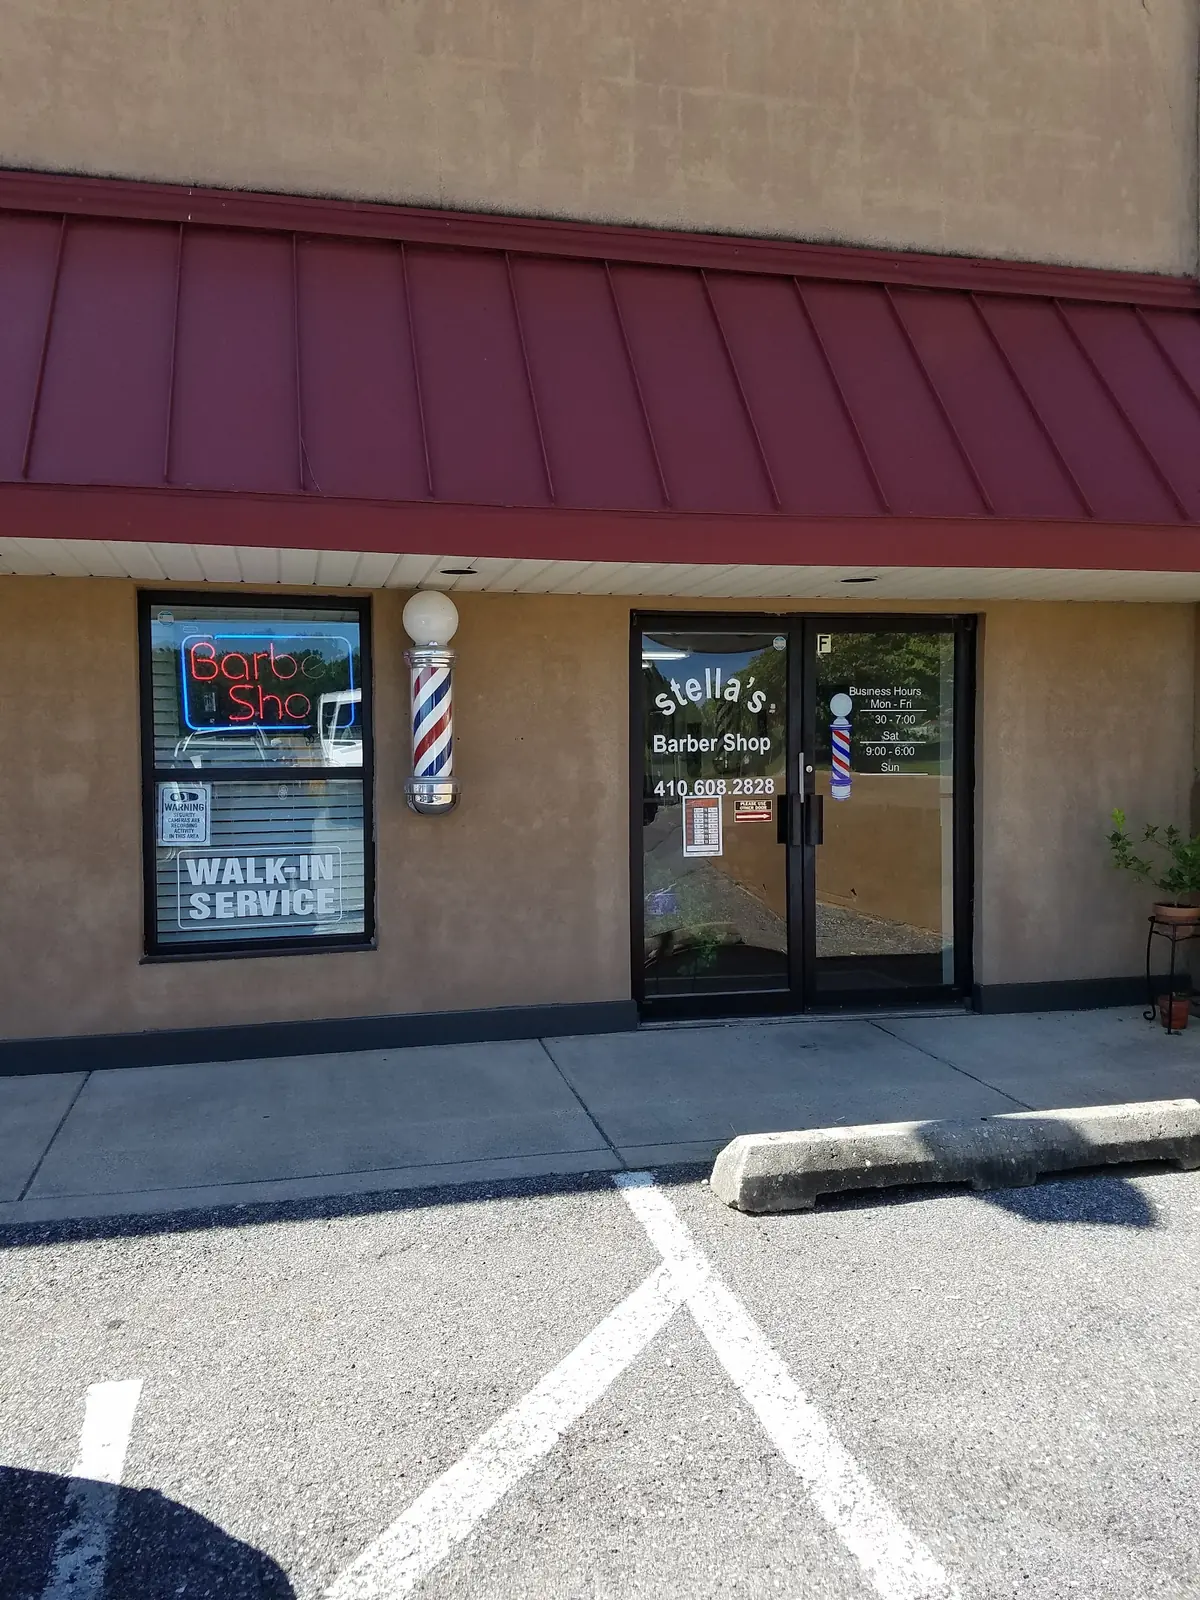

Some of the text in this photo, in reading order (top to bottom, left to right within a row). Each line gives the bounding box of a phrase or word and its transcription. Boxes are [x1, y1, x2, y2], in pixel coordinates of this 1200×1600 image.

[819, 635, 830, 652] F
[849, 686, 922, 696] Business Hours
[228, 684, 322, 721] Sho
[870, 699, 891, 709] Mon
[900, 699, 912, 708] Fri
[875, 714, 887, 725] 30
[895, 714, 916, 725] 7:00
[883, 731, 899, 741] Sat
[653, 733, 771, 755] Barber Shop
[865, 747, 886, 756] 9:00
[894, 747, 915, 756] 6:00
[880, 763, 900, 772] Sun
[654, 778, 774, 796] 410.608.2828
[164, 803, 204, 811] WARNING
[185, 854, 334, 886] WALK-IN
[189, 887, 336, 920] SERVICE
